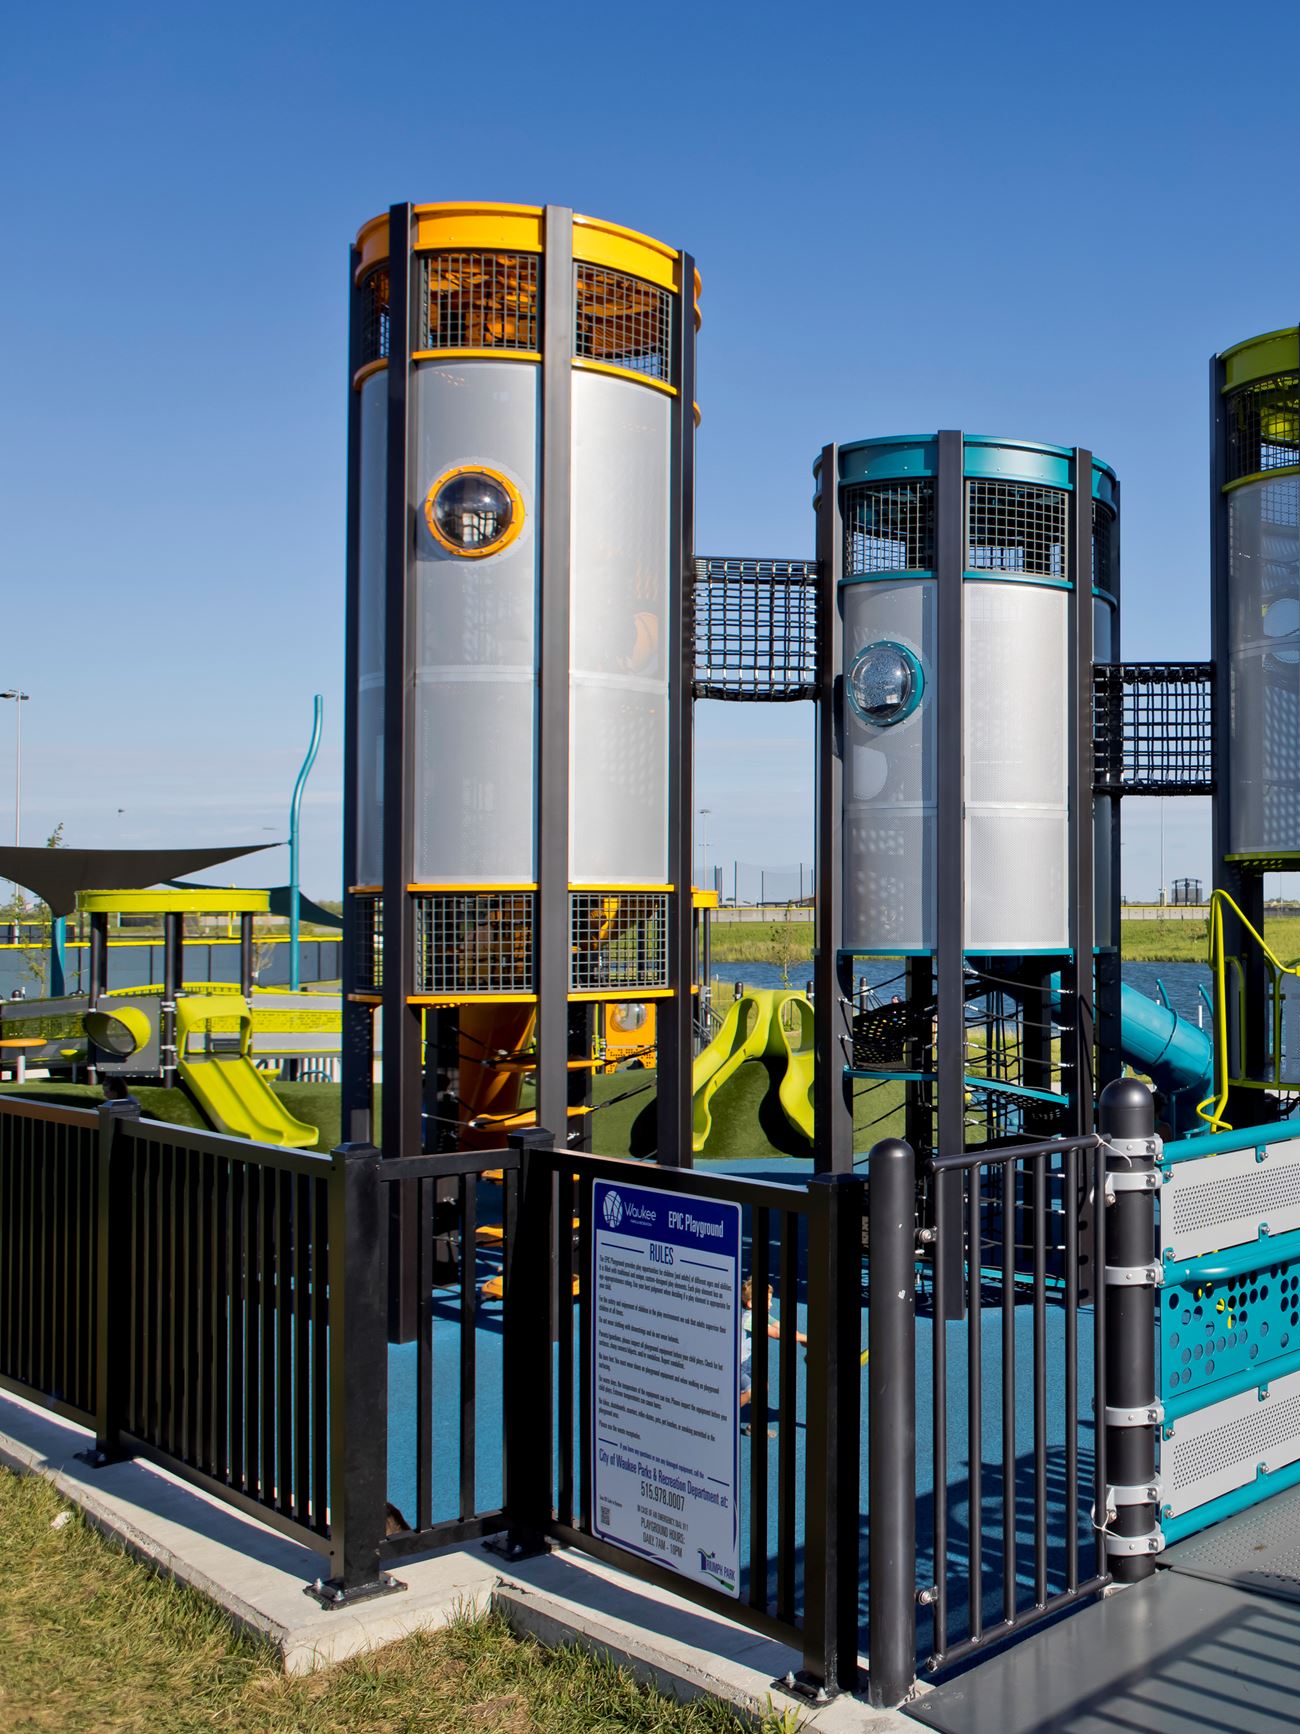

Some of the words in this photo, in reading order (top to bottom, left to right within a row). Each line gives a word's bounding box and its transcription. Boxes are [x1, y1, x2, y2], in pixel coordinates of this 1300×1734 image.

[624, 1202, 657, 1221] Waukee
[668, 1211, 684, 1230] EPIC
[685, 1214, 724, 1238] Playground
[649, 1243, 674, 1266] RULES
[599, 1448, 609, 1467] City
[610, 1453, 616, 1466] of
[616, 1455, 637, 1474] Waukee
[638, 1462, 652, 1480] Parks
[652, 1468, 657, 1481] &
[658, 1470, 687, 1492] Recreation
[687, 1480, 720, 1505] Department
[641, 1481, 685, 1512] 515.978.0007
[640, 1517, 669, 1538] PLAYGROUND
[669, 1528, 685, 1544] HOURS:
[643, 1532, 655, 1547] DAILY
[655, 1537, 666, 1552] 7AM
[723, 1566, 736, 1582] PARK
